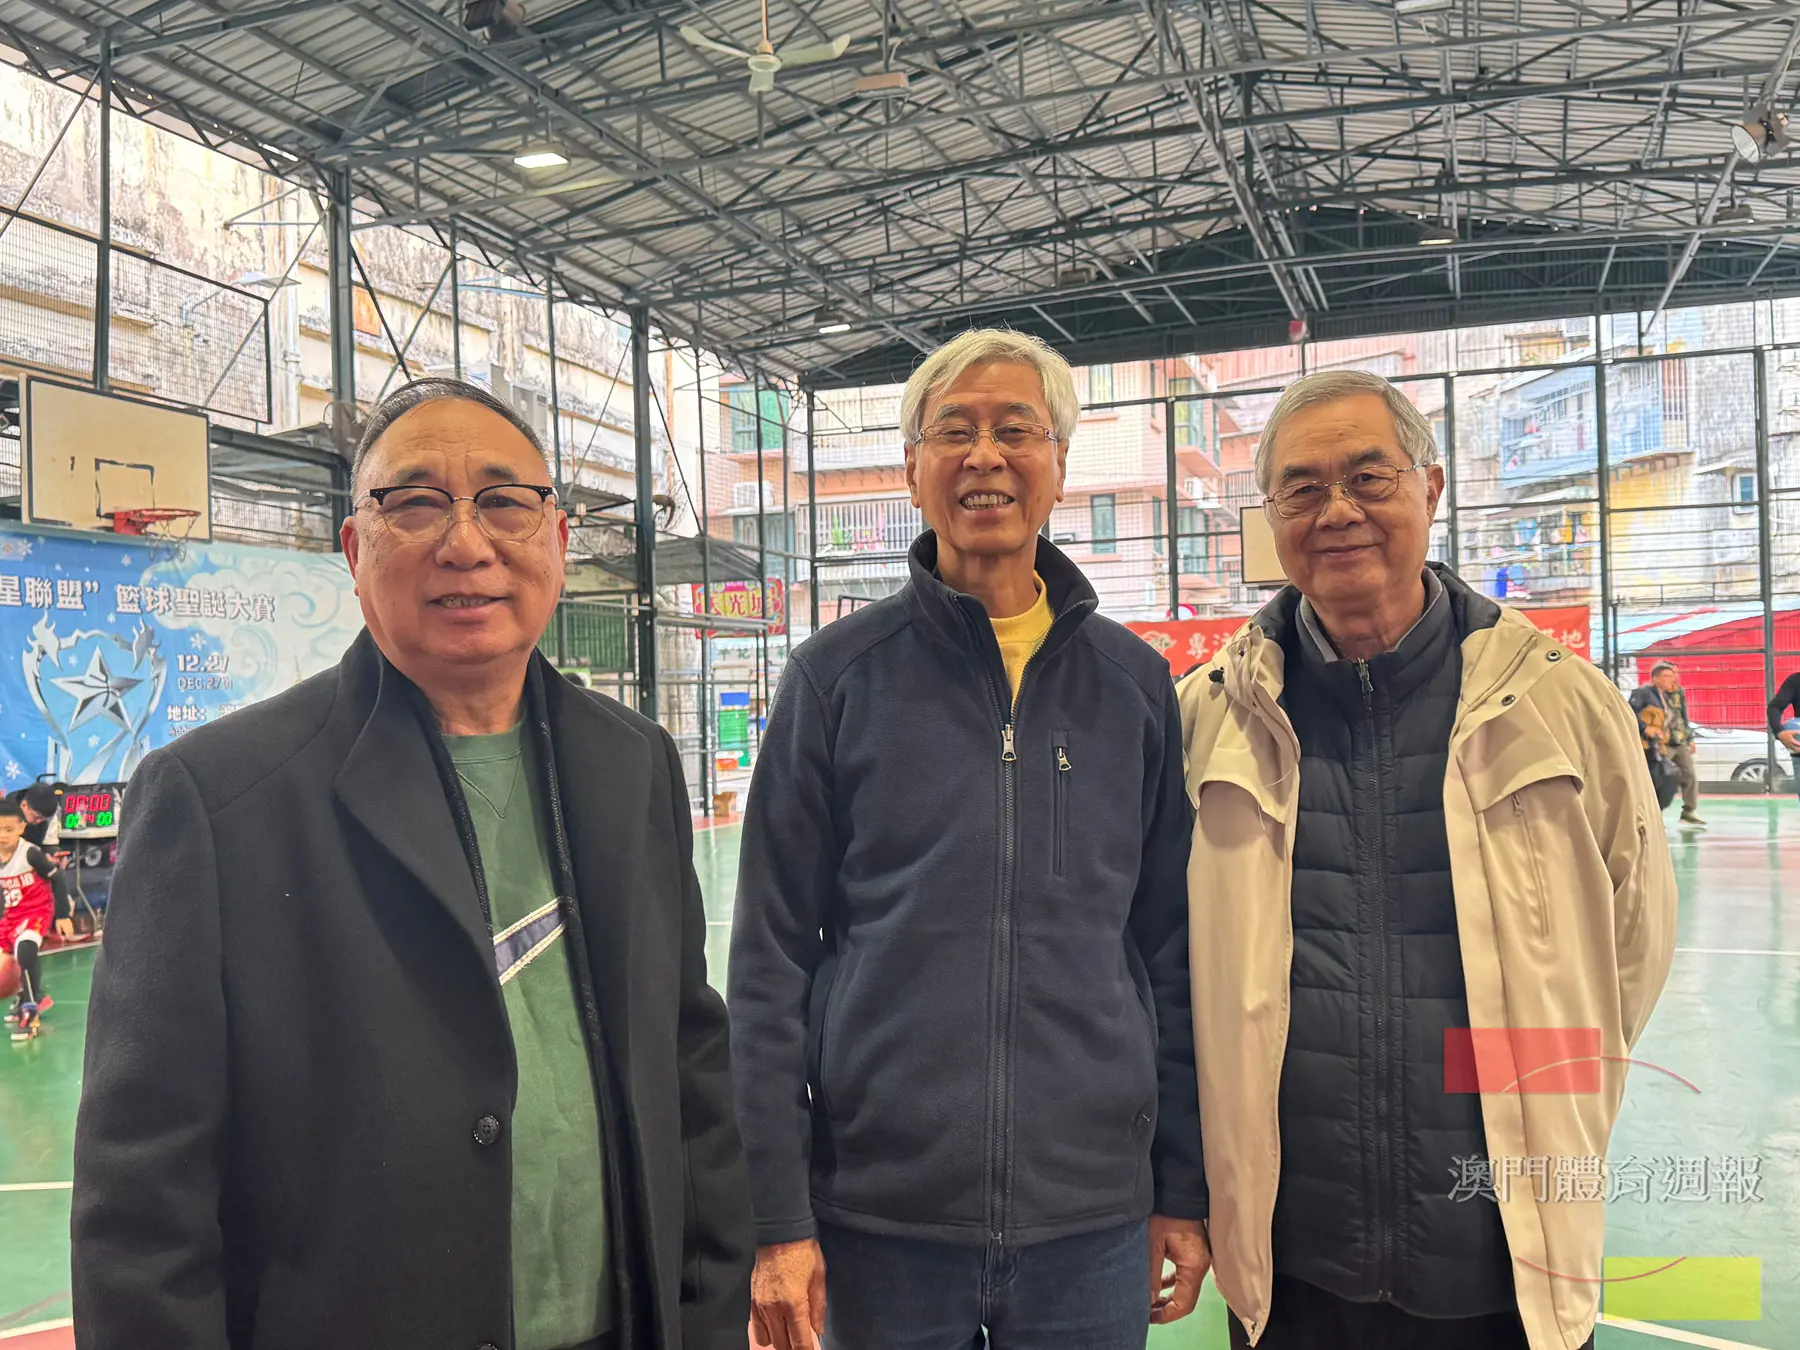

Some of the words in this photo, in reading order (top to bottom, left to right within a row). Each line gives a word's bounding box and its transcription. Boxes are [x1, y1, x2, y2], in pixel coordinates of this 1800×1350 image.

[115, 583, 275, 622] 籃球聖誕大賽
[177, 653, 229, 673] 12.27
